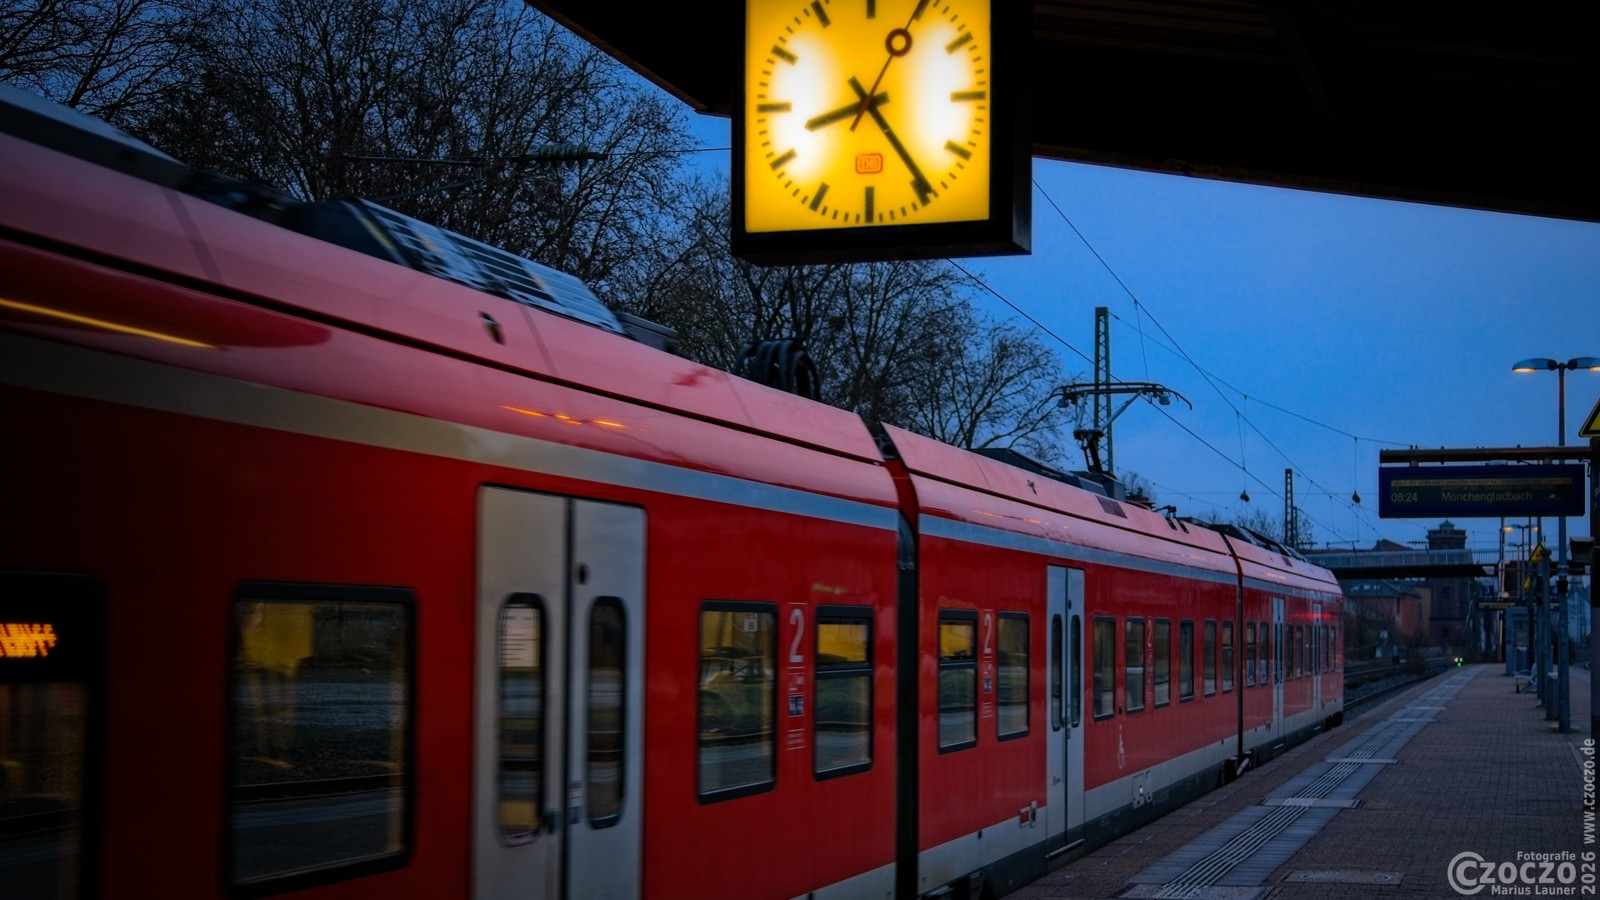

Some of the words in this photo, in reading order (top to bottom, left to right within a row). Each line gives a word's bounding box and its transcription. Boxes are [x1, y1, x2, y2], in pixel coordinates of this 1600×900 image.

[1391, 492, 1418, 502] 08:24
[789, 608, 805, 663] 2
[983, 613, 993, 654] 2
